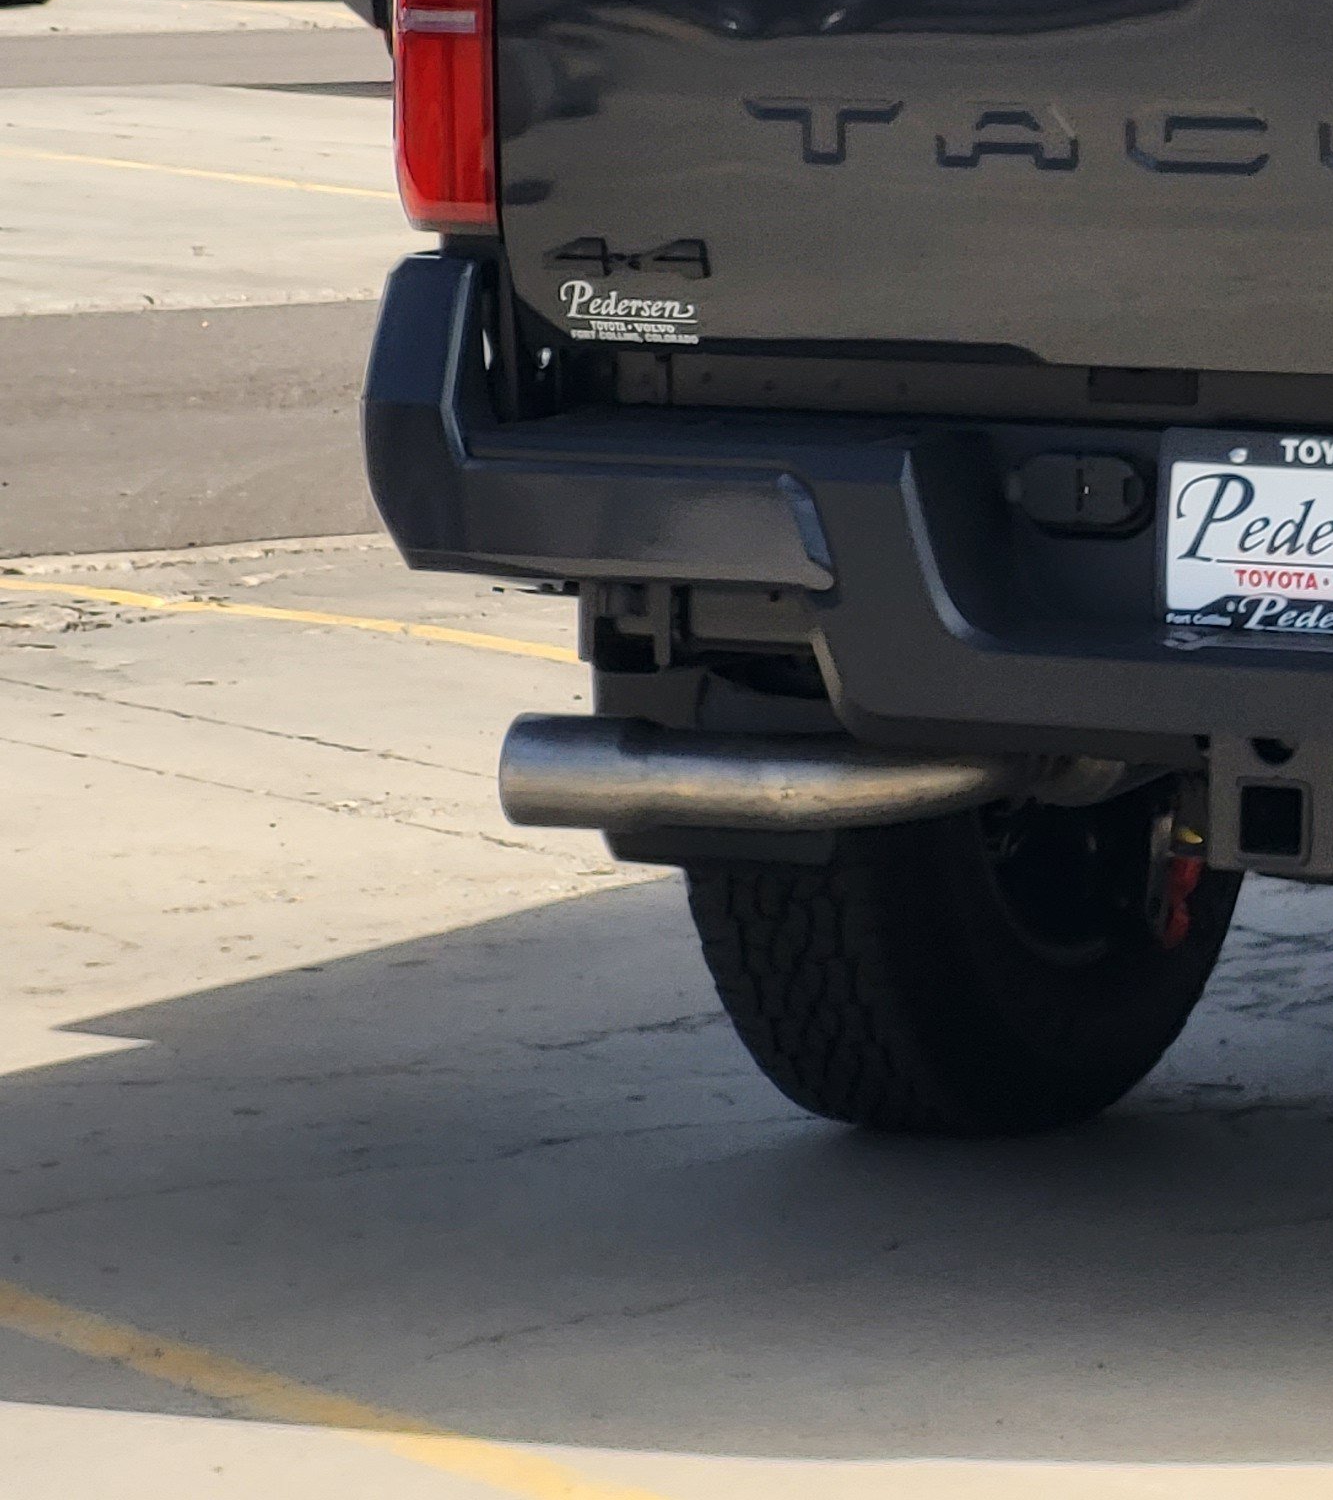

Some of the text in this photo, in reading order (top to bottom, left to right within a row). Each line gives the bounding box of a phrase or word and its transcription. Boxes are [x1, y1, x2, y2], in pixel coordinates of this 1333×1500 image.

[559, 279, 696, 319] Pedersen
[590, 320, 676, 334] TOYOTA VOLVO
[1234, 568, 1319, 591] TOYOTA
